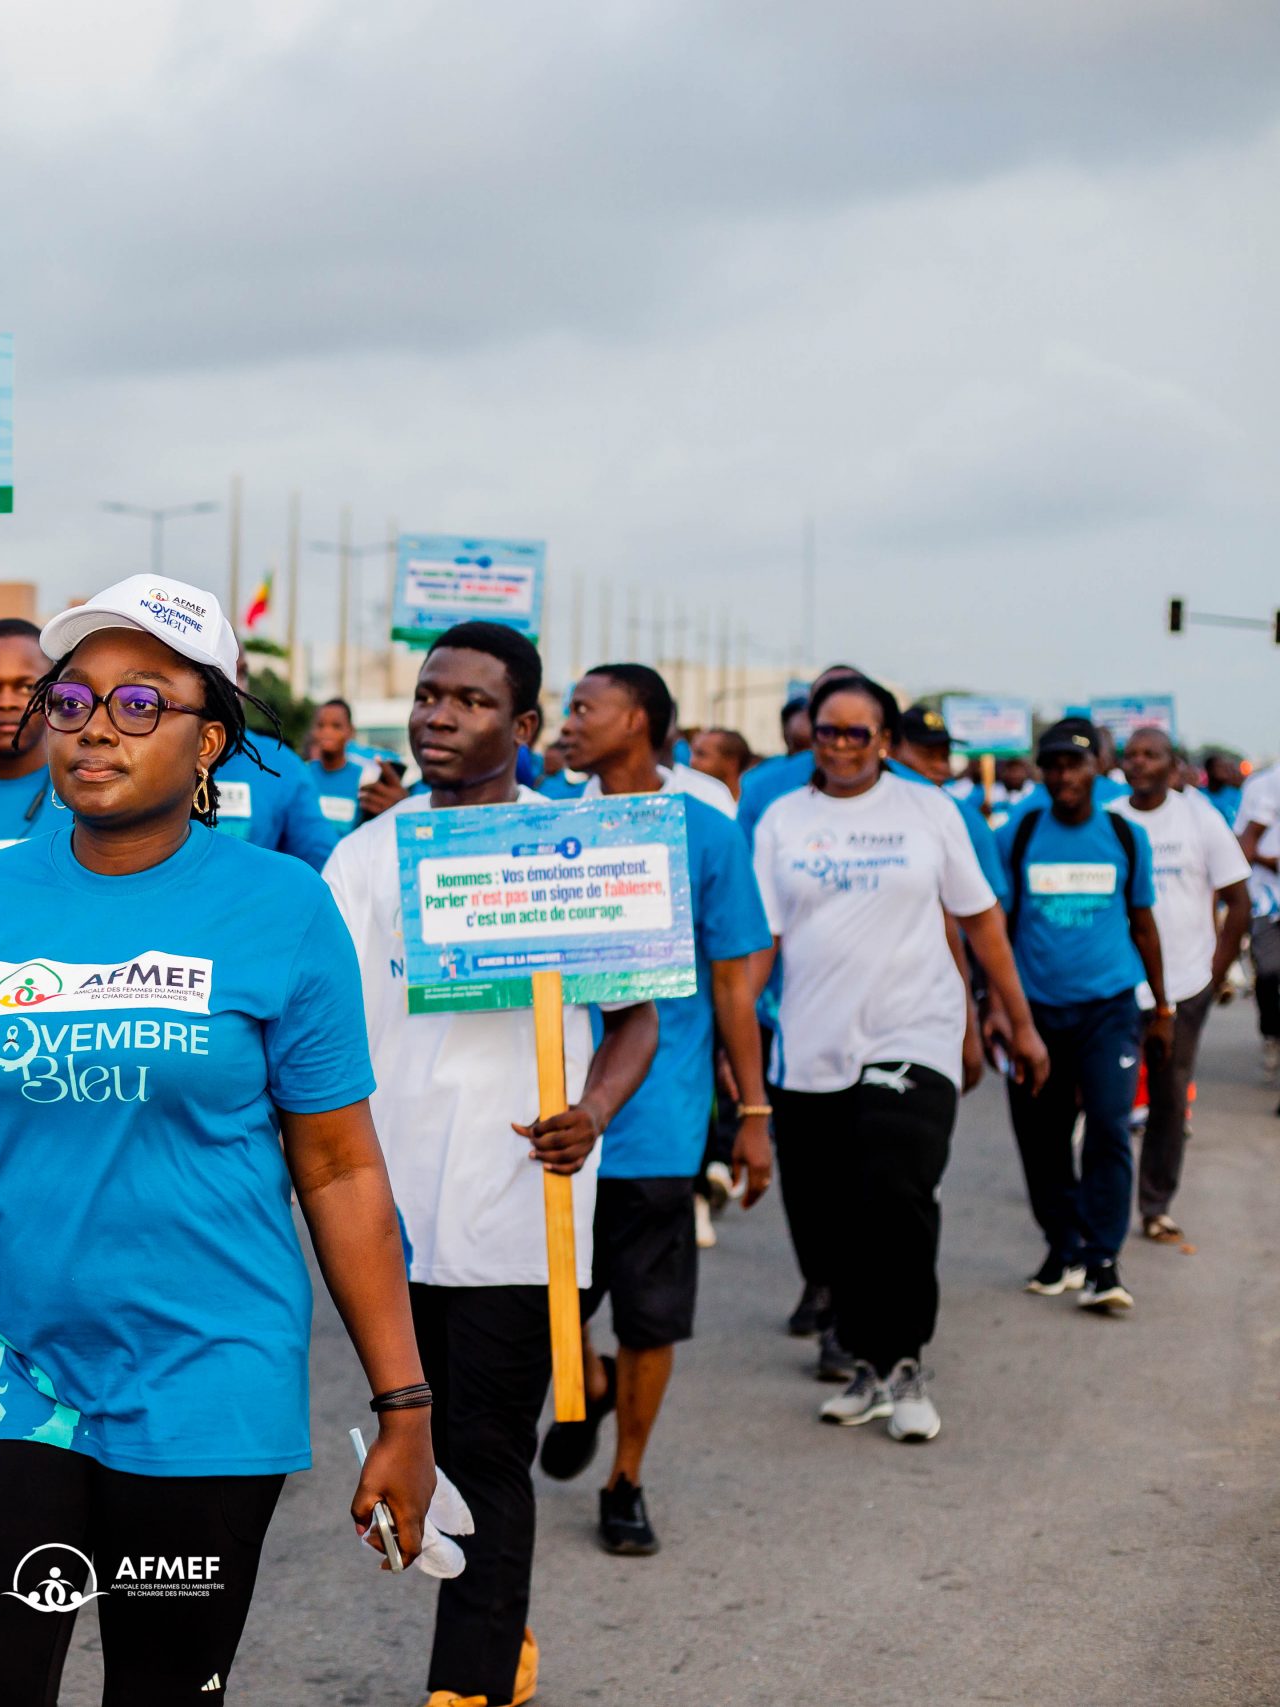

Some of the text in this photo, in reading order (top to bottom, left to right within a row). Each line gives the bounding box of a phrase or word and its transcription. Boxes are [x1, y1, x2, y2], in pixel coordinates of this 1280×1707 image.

[140, 600, 203, 633] NOVEMBRE
[172, 596, 206, 614] AFMEF
[154, 612, 187, 634] Bleu
[437, 872, 492, 888] Hommes
[502, 868, 524, 883] Vos
[528, 863, 585, 881] émotions
[425, 893, 468, 910] Parler
[471, 890, 502, 906] n'est
[506, 891, 528, 907] pas
[532, 888, 546, 903] un
[550, 884, 583, 904] signe
[587, 883, 601, 898] de
[467, 912, 497, 928] c'est
[501, 910, 515, 924] un
[520, 907, 546, 923] acte
[550, 905, 565, 920] de
[79, 963, 206, 989] AFMEF
[73, 987, 105, 995] AMICALE
[167, 989, 205, 999] MINISTÈRE
[151, 993, 188, 1001] FINANCES
[21, 1053, 150, 1103] Bleu
